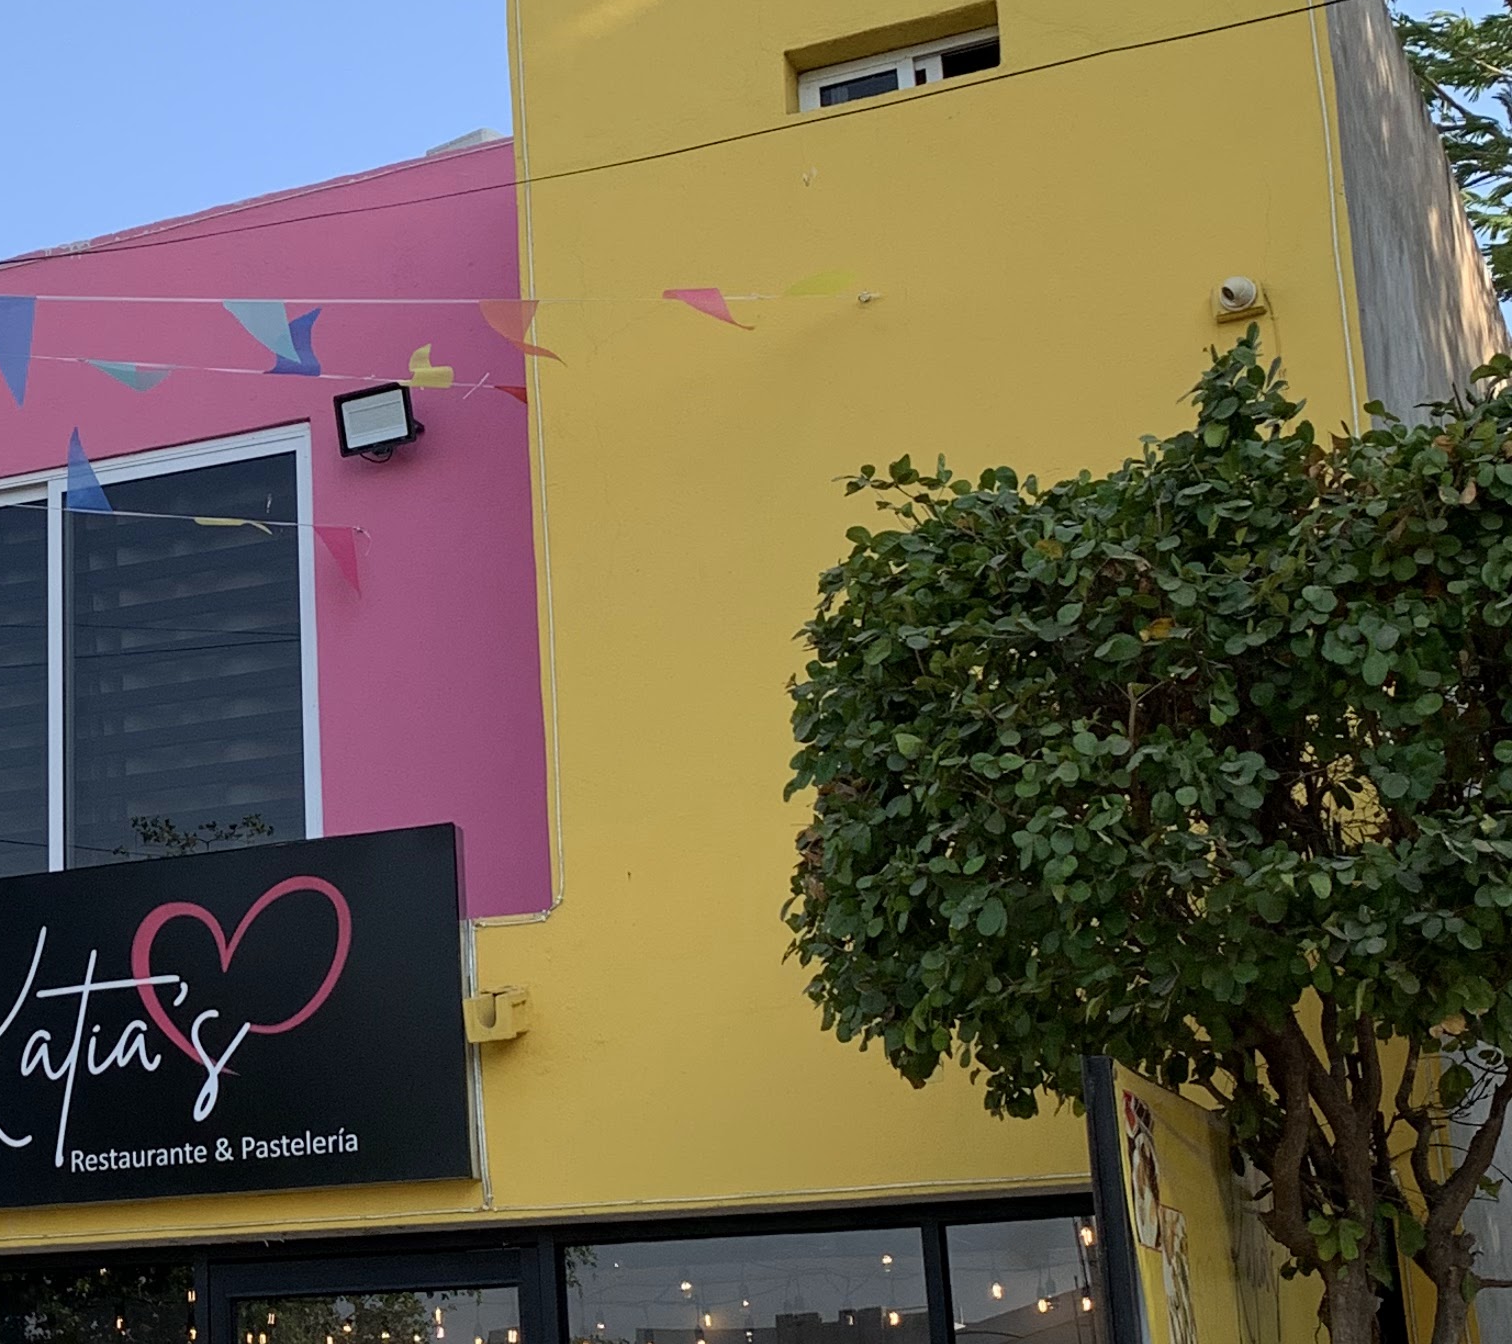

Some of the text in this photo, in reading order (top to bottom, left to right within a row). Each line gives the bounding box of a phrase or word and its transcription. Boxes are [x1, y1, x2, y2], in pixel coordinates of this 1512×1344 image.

[71, 1127, 359, 1173] Restaurante & Pastelería
